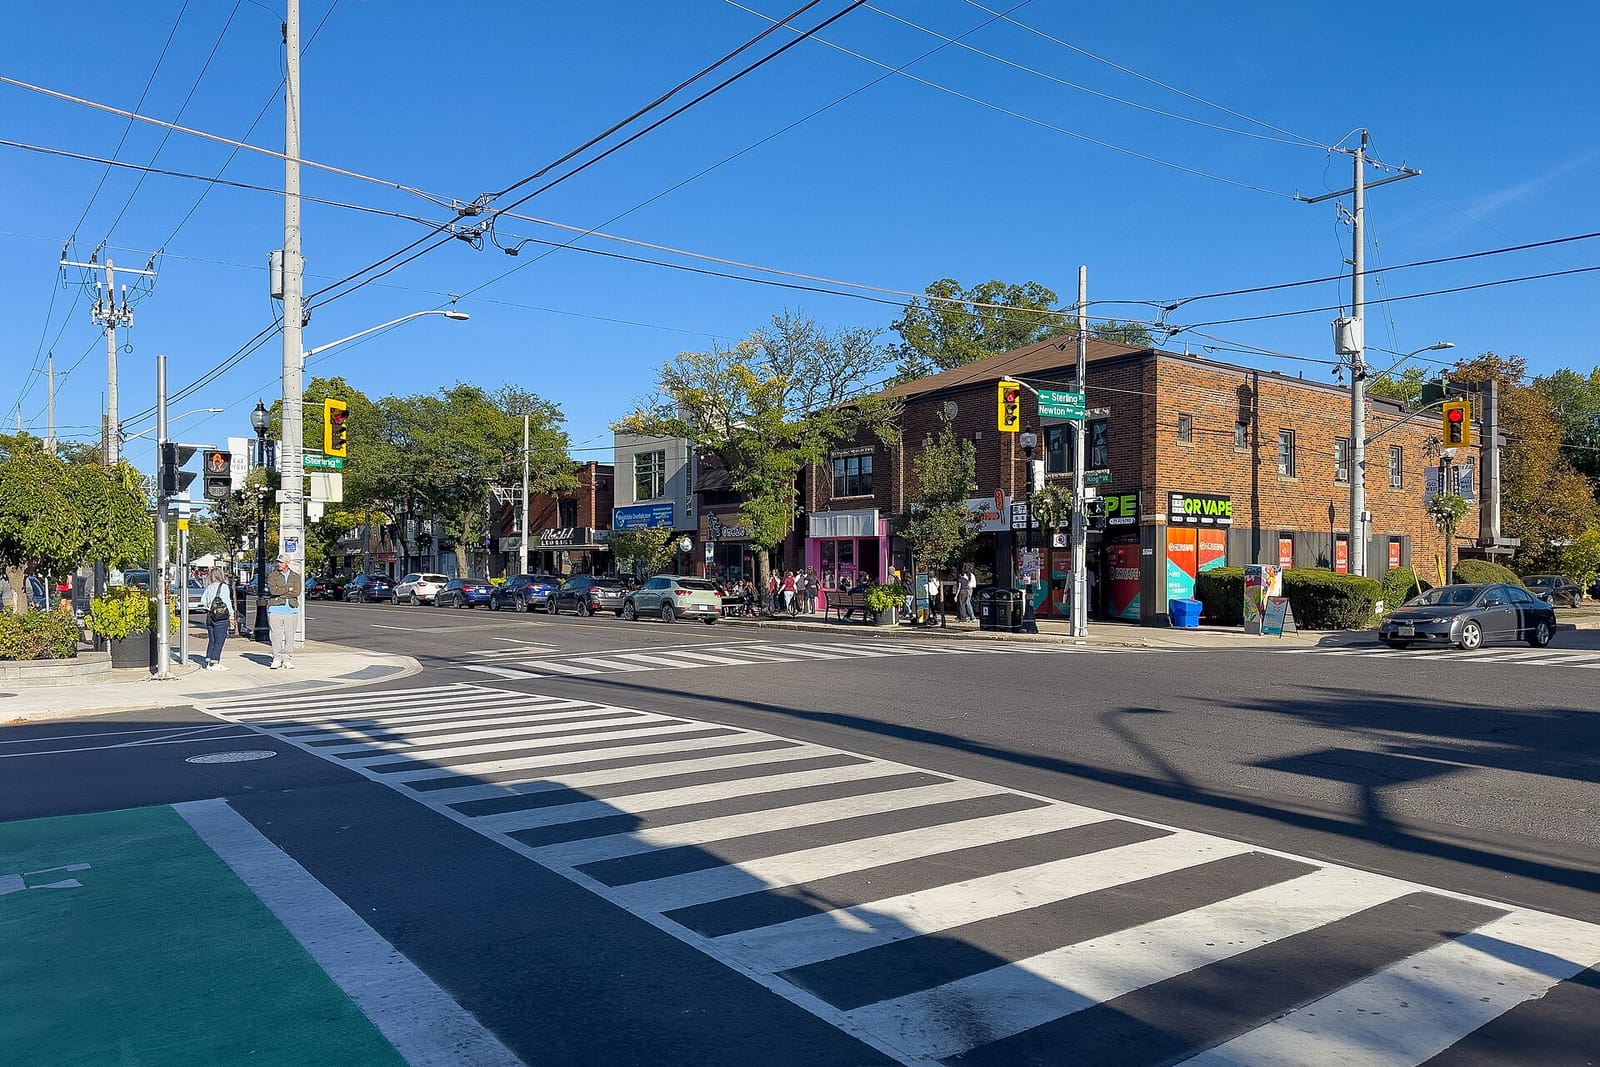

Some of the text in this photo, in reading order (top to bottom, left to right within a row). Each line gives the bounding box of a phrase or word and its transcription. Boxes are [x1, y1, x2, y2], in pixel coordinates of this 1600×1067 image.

[1051, 392, 1078, 404] Sterling
[1039, 405, 1066, 416] Newton
[304, 456, 336, 467] Sterling
[1184, 498, 1202, 516] QR
[1202, 499, 1233, 516] VAPE
